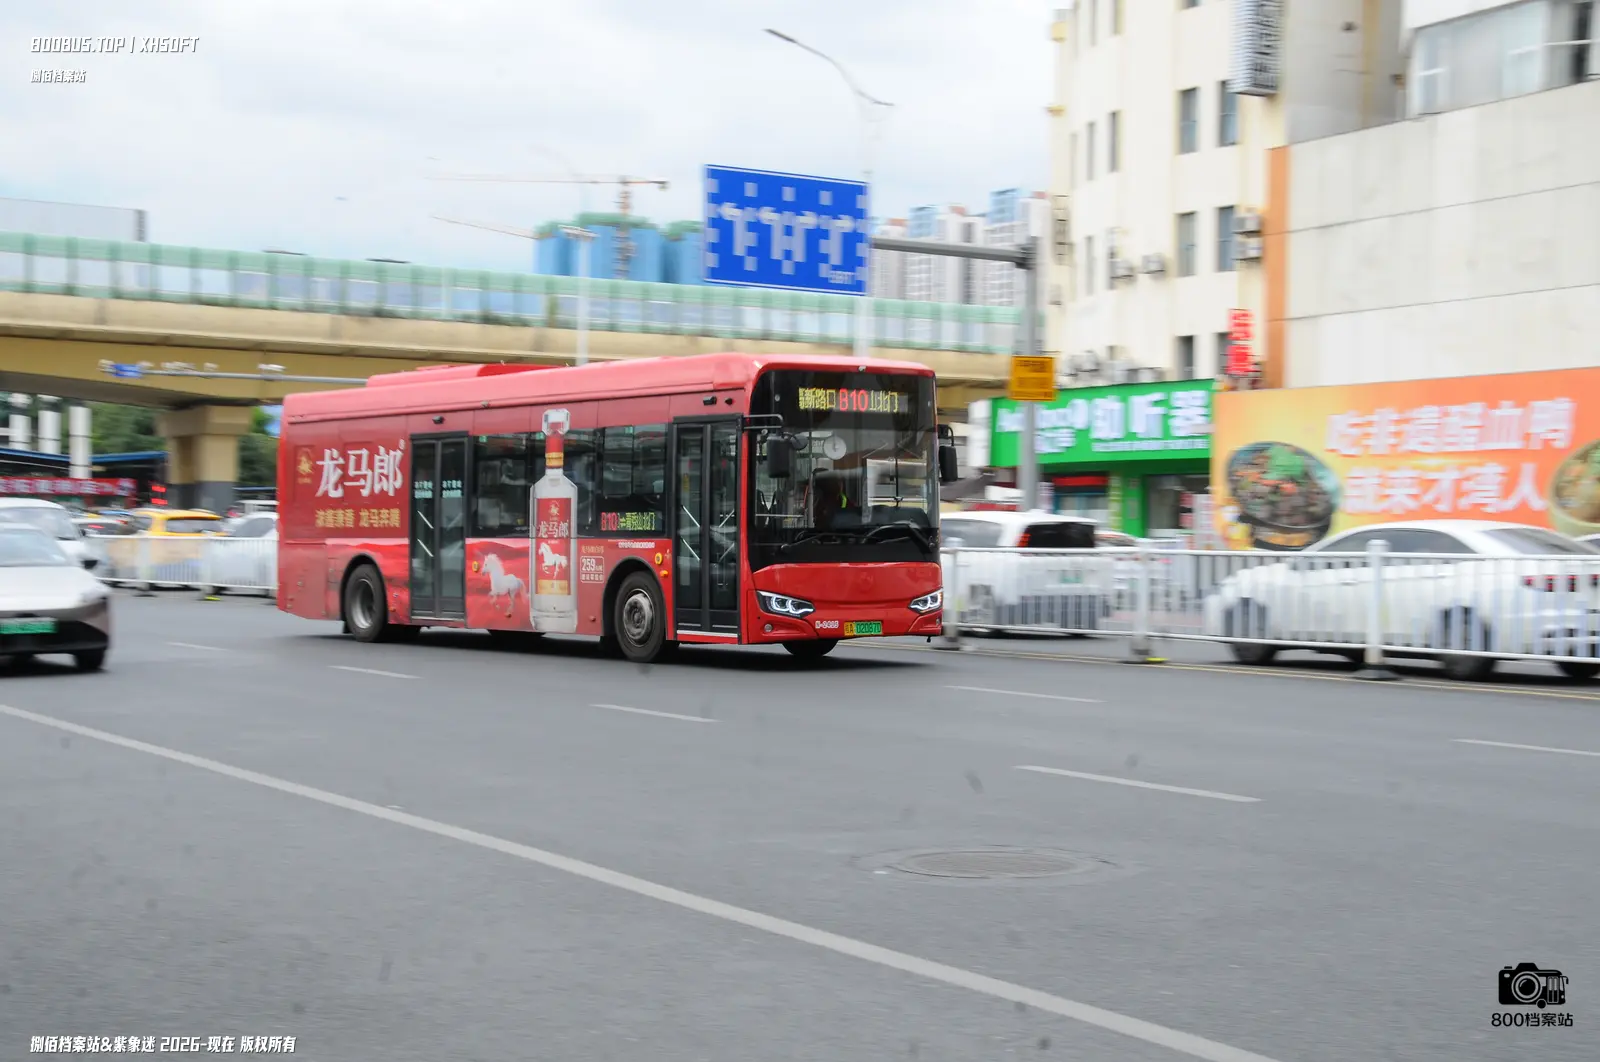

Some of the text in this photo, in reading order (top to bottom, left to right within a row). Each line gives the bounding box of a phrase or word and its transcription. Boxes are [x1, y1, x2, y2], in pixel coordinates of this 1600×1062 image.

[839, 387, 869, 412] B10
[315, 445, 404, 498] 龙马郎
